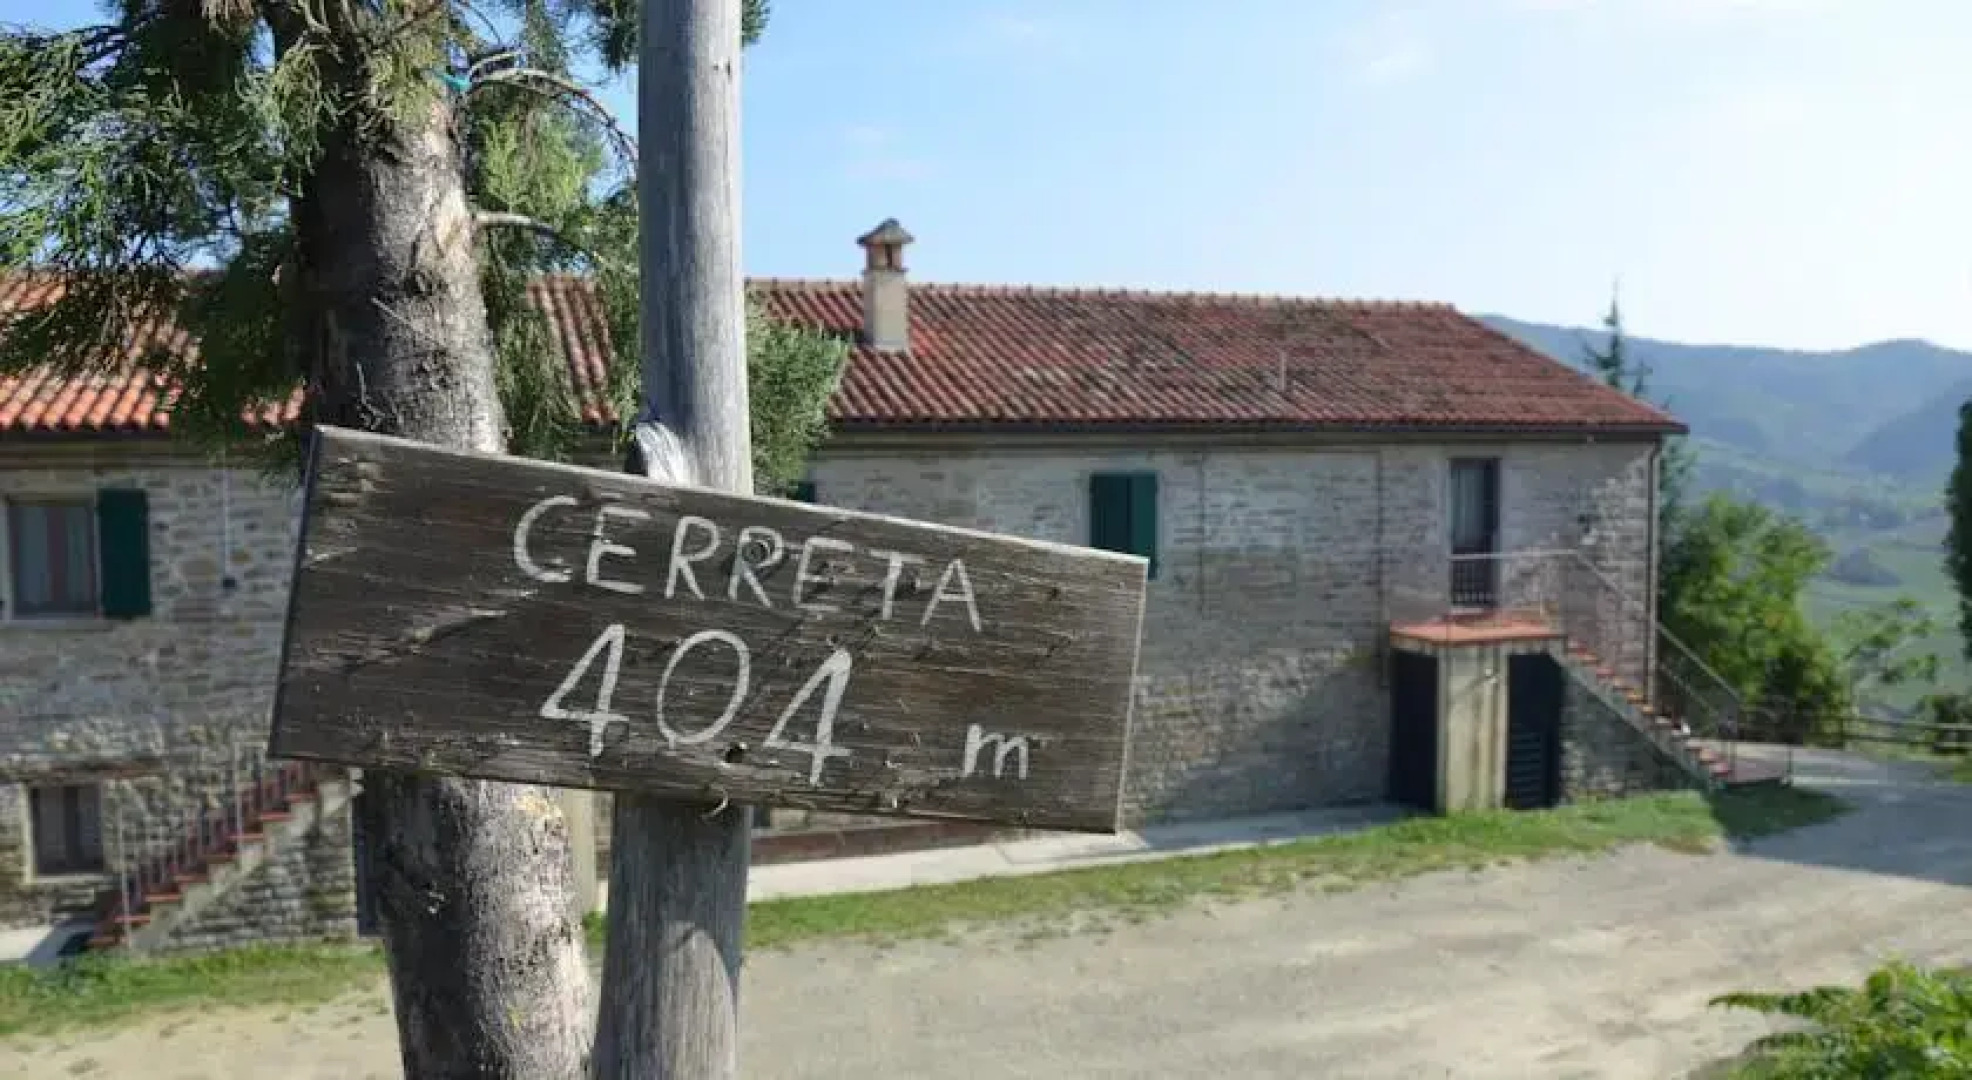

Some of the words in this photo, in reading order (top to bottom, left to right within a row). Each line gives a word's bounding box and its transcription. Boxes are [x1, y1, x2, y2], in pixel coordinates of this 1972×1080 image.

[514, 496, 982, 632] CERRETA
[540, 624, 853, 787] 404
[963, 722, 1030, 780] m
